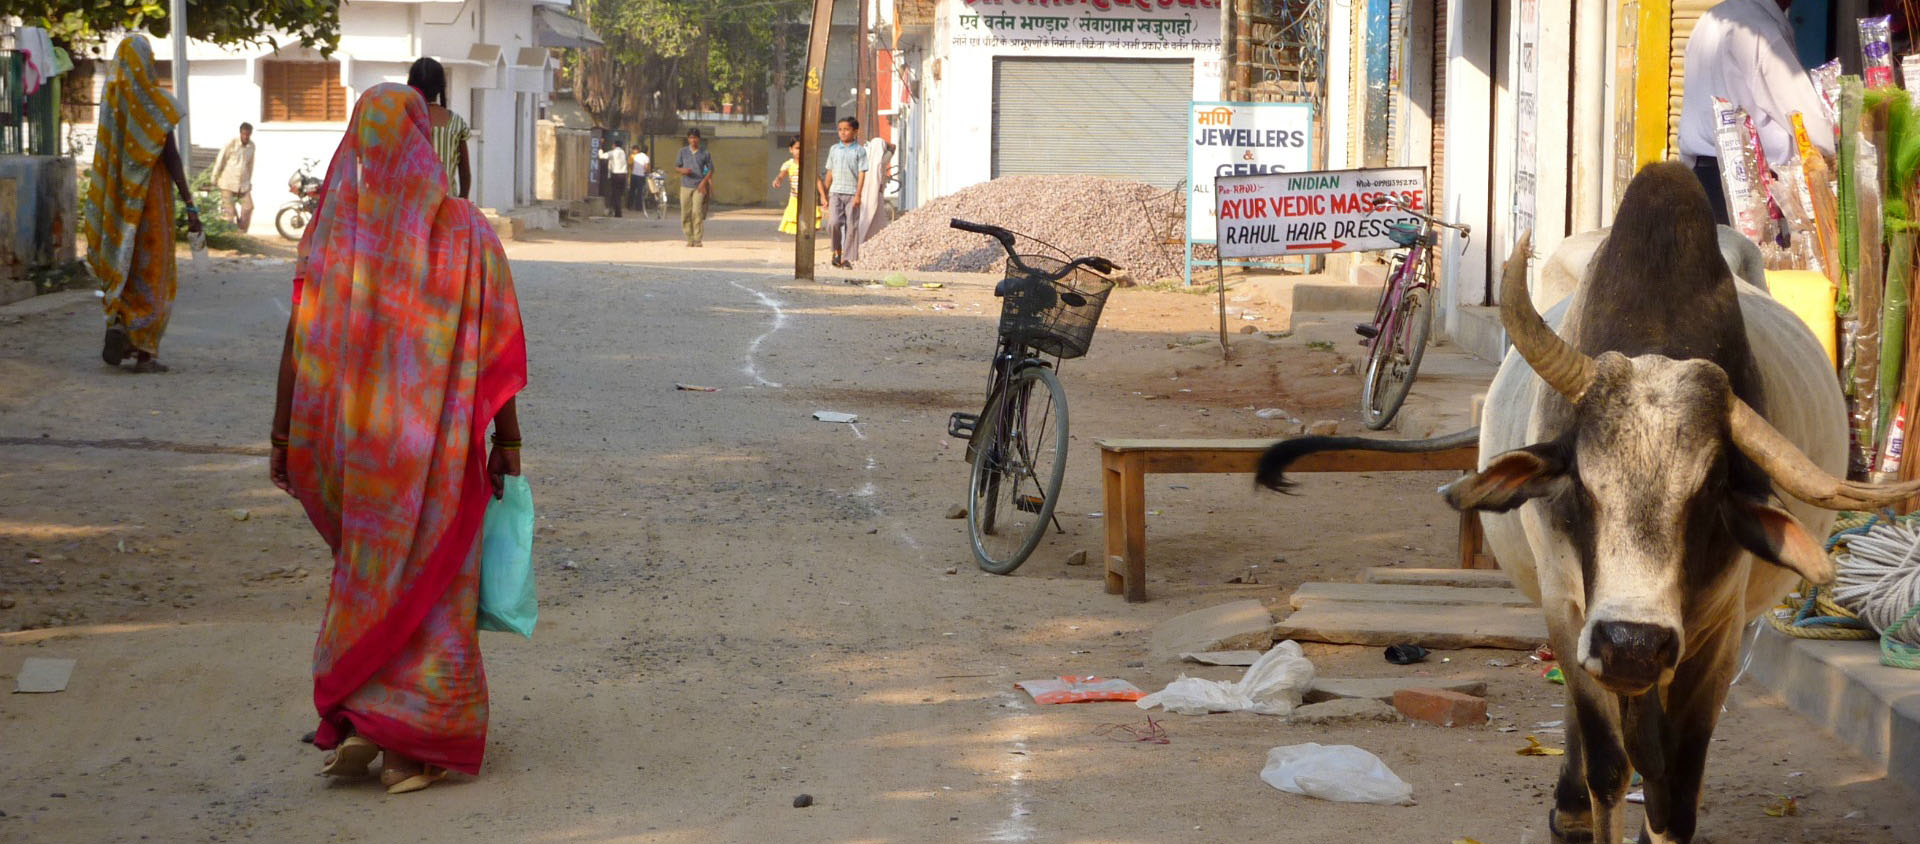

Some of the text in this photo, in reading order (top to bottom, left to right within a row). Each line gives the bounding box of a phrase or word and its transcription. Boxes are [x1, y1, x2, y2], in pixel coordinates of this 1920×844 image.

[959, 11, 980, 29] एवं
[1195, 128, 1304, 148] JEWELLERS
[1243, 149, 1254, 160] &
[1194, 184, 1209, 193] ALL
[1287, 175, 1340, 191] INIDIAN
[1220, 197, 1267, 219] AYUR
[1269, 194, 1326, 217] VEDIC
[1226, 224, 1280, 244] RAHUL
[1286, 222, 1327, 241] HAIR
